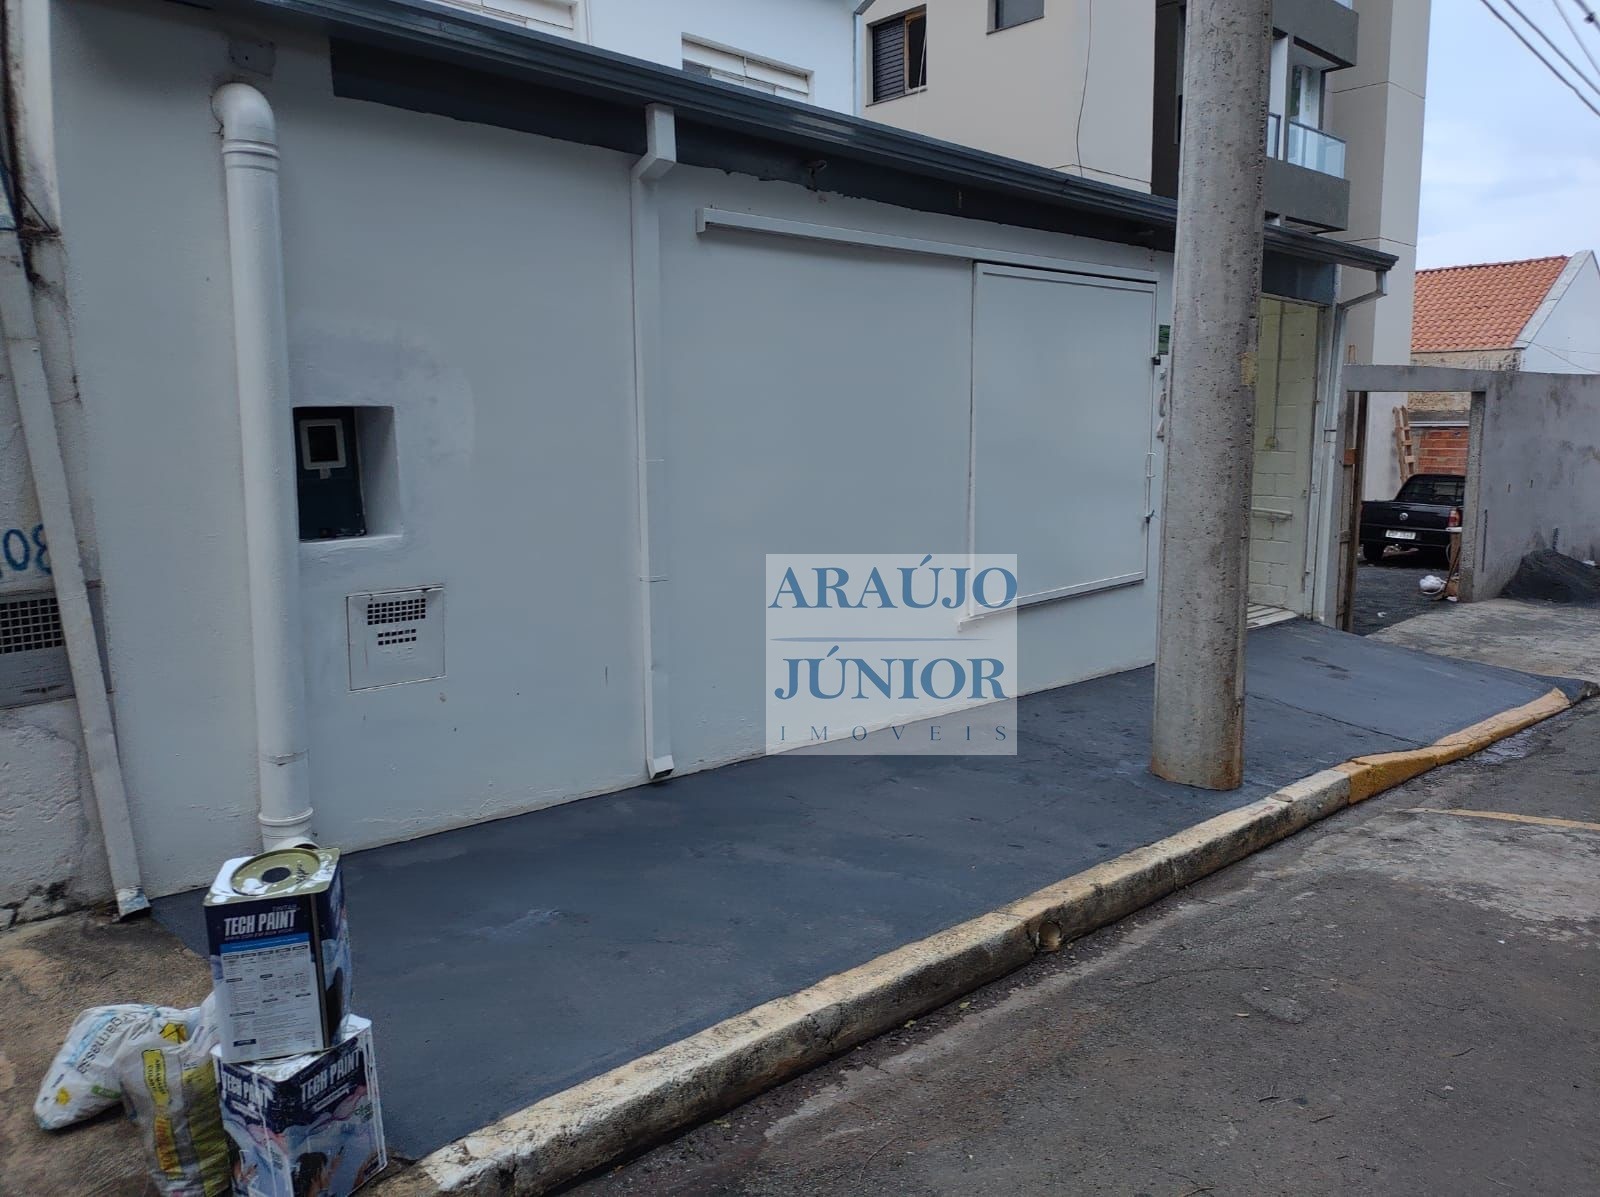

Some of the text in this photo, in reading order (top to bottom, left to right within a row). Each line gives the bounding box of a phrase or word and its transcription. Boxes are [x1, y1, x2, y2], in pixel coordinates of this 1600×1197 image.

[223, 914, 256, 937] TECH
[258, 909, 297, 932] PAINT
[301, 1069, 329, 1104] TECH
[331, 1048, 361, 1083] PAINT
